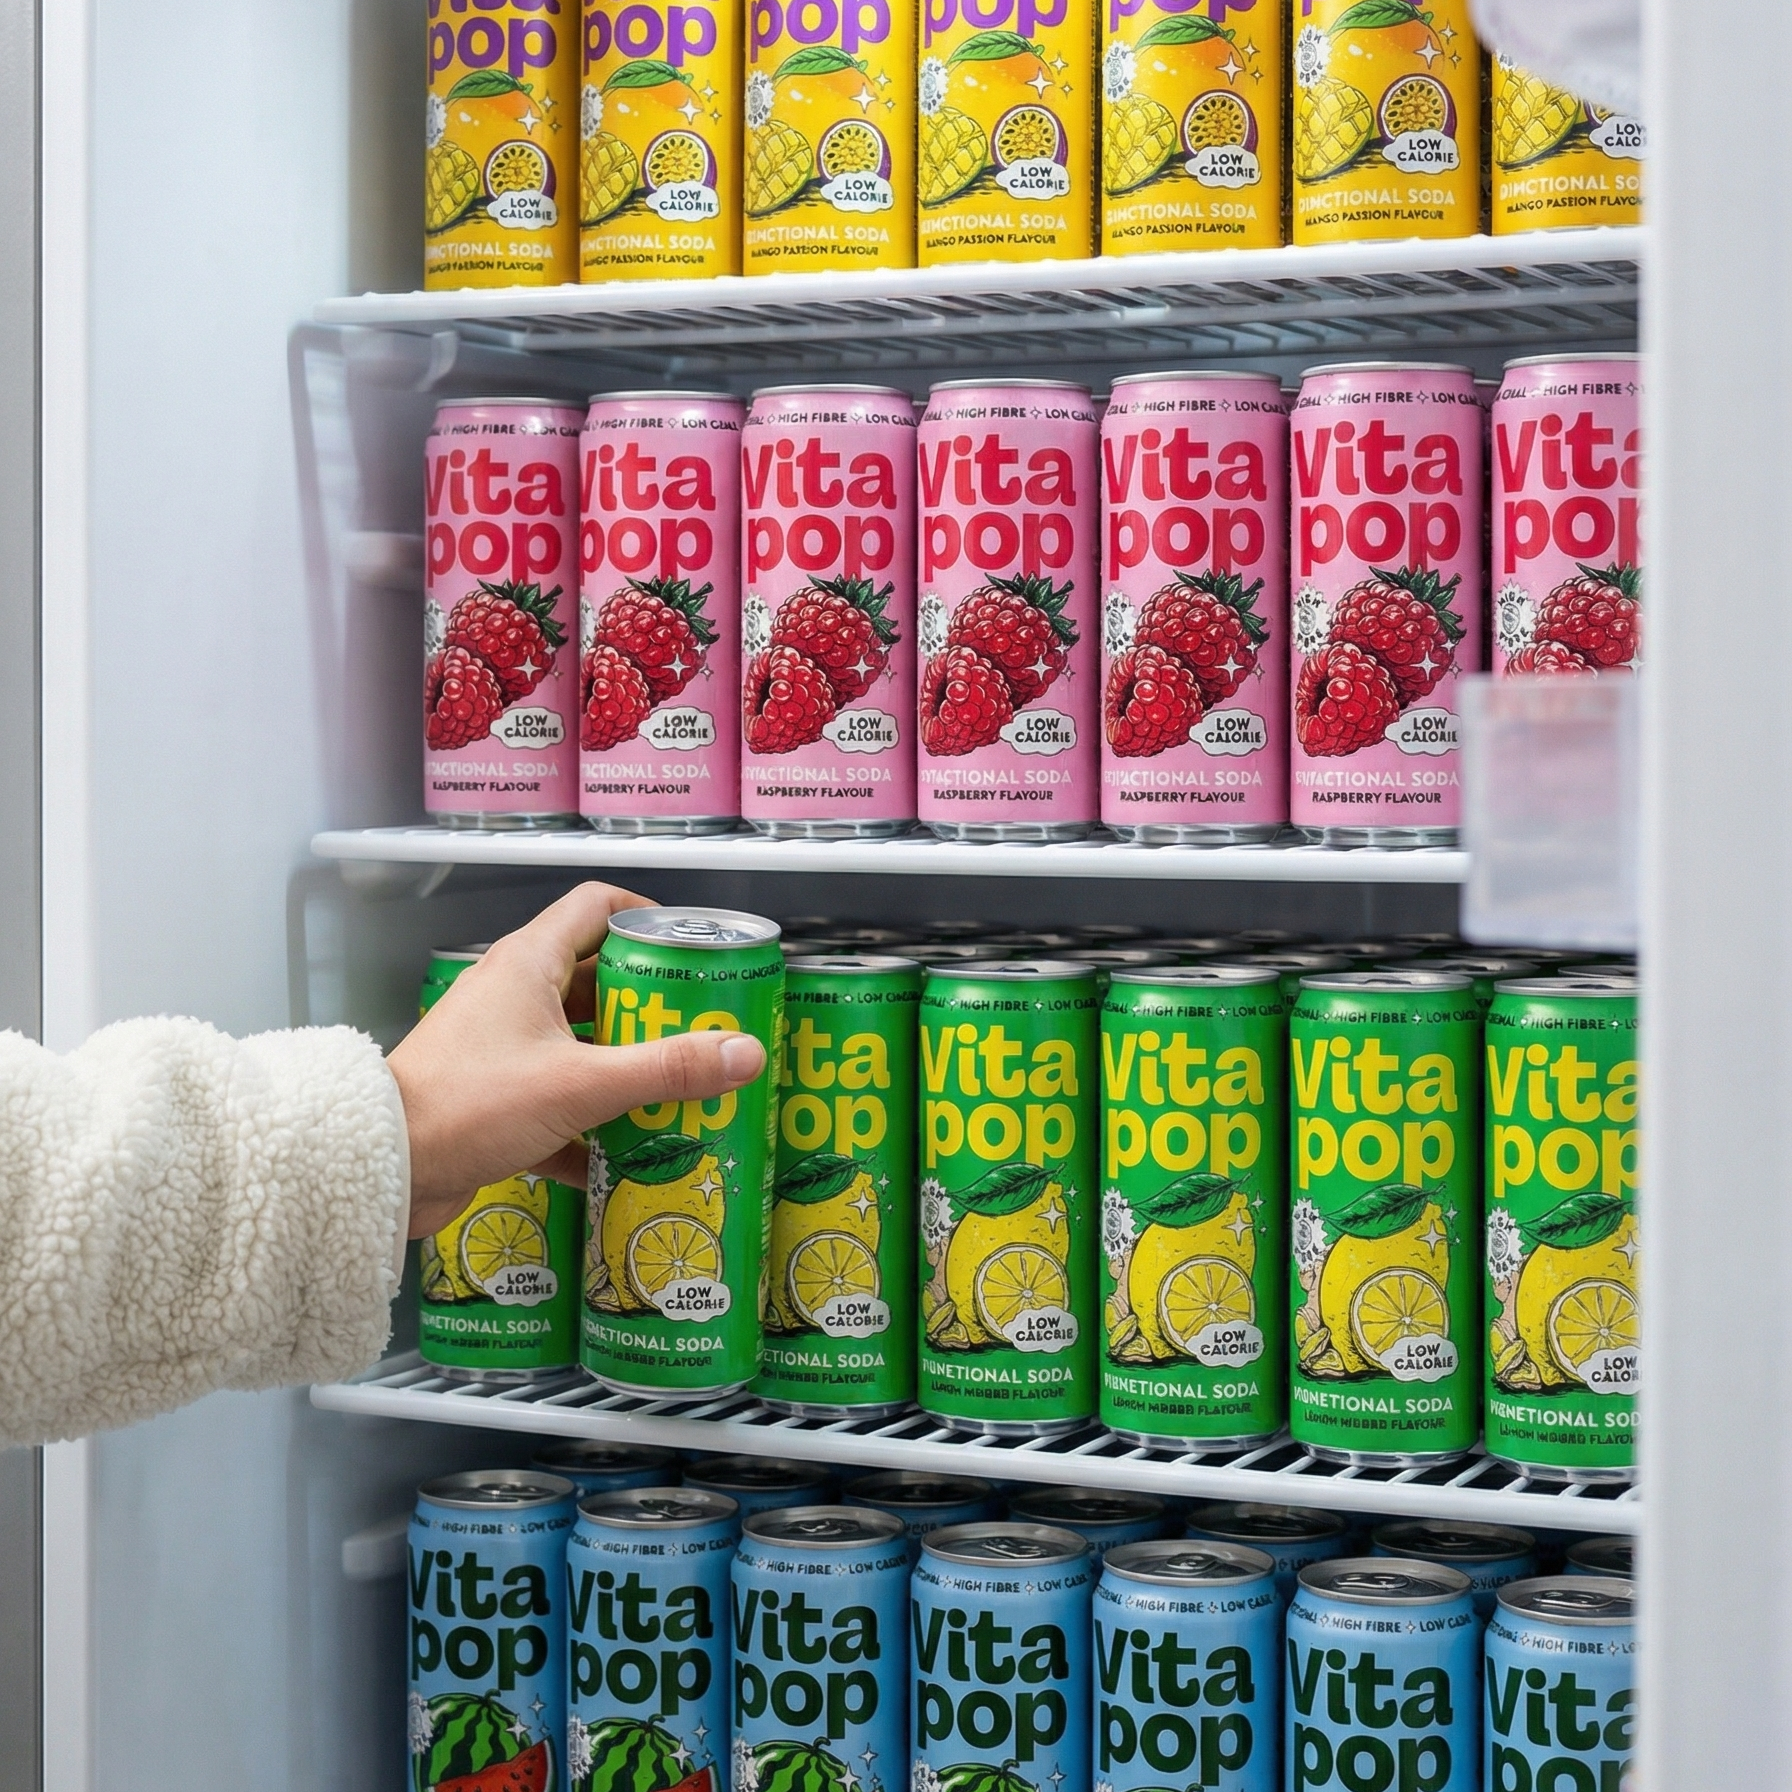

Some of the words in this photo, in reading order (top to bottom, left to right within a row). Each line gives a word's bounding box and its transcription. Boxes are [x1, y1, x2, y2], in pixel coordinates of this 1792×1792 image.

[750, 0, 891, 63] pop
[584, 4, 717, 76] pop
[429, 16, 557, 85] pop
[1409, 139, 1442, 151] LOW
[1211, 154, 1244, 165] LOW
[1021, 166, 1054, 178] LOW
[845, 179, 877, 190] LOW
[1009, 178, 1065, 190] CALORIE
[670, 189, 701, 200] LOW
[1408, 189, 1455, 206] SODA
[510, 198, 541, 208] LOW
[1209, 203, 1257, 220] SODA
[1020, 215, 1067, 230] SODA
[669, 234, 716, 250] SODA
[844, 227, 890, 242] SODA
[508, 243, 554, 258] SODA
[1338, 393, 1371, 404] HIGH
[1375, 392, 1413, 403] FIBRE
[1543, 384, 1578, 396] HIGH
[1582, 384, 1622, 395] FIBRE
[956, 408, 986, 418] HIGH
[991, 407, 1026, 418] FIBRE
[1144, 401, 1175, 411] HIGH
[1179, 400, 1216, 411] FIBRE
[630, 418, 663, 428] FIBRE
[778, 413, 807, 423] HIGH
[812, 413, 847, 422] FIBRE
[482, 424, 515, 434] FIBRE
[1104, 427, 1267, 504] Vita
[1294, 420, 1463, 498] Vita
[580, 442, 716, 513] Vita
[743, 438, 897, 510] Vita
[919, 434, 1076, 508] Vita
[425, 448, 565, 516] Vita
[924, 511, 1074, 583] pop
[1110, 506, 1265, 581] pop
[1300, 501, 1461, 577] pop
[427, 521, 562, 588] pop
[580, 517, 713, 587] pop
[747, 514, 894, 584] pop
[515, 715, 548, 726] LOW
[664, 716, 698, 727] LOW
[849, 717, 882, 730] LOW
[1026, 718, 1060, 731] LOW
[1216, 718, 1250, 730] LOW
[1413, 717, 1447, 730] LOW
[512, 762, 558, 777] SODA
[662, 764, 711, 779] SODA
[846, 767, 892, 782] SODA
[1024, 770, 1072, 784] SODA
[1215, 770, 1262, 786] SODA
[1411, 771, 1460, 787] SODA
[638, 784, 690, 794] FLAVOUR
[1190, 792, 1246, 803] FLAVOUR
[1313, 792, 1382, 803] RASPBERRY
[1385, 792, 1441, 803] FLAVOUR
[655, 967, 693, 980] FIBRE
[711, 969, 737, 982] LOW
[1177, 1006, 1213, 1018] FIBRE
[1567, 1019, 1606, 1029] FIBRE
[781, 1018, 891, 1090] ita
[921, 1023, 1079, 1098] Vita
[1102, 1030, 1265, 1107] Vita
[1292, 1036, 1458, 1114] Vita
[1487, 1043, 1641, 1123] Vita
[781, 1093, 887, 1159] op
[926, 1099, 1076, 1169] pop
[1107, 1108, 1261, 1180] pop
[1298, 1117, 1455, 1190] pop
[1494, 1125, 1643, 1198] pop
[507, 1272, 540, 1285] LOW
[676, 1286, 711, 1299] LOW
[837, 1303, 871, 1315] LOW
[507, 1318, 552, 1334] SODA
[1027, 1316, 1061, 1330] LOW
[675, 1336, 724, 1352] SODA
[1213, 1330, 1246, 1343] LOW
[1201, 1342, 1259, 1355] CALORIE
[1407, 1344, 1441, 1357] LOW
[837, 1352, 885, 1368] SODA
[1604, 1356, 1637, 1370] LOW
[1027, 1367, 1074, 1383] SODA
[1213, 1381, 1260, 1399] SODA
[1406, 1397, 1453, 1414] SODA
[1604, 1412, 1641, 1428] SOD
[682, 1541, 706, 1554] LOW
[767, 1560, 794, 1573] HIGH
[798, 1564, 832, 1575] FIBRE
[849, 1563, 873, 1574] LOW
[409, 1543, 550, 1620] Vita
[953, 1578, 982, 1592] HIGH
[986, 1582, 1020, 1592] FIBRE
[1038, 1580, 1061, 1592] LOW
[567, 1562, 714, 1644] Vita
[1169, 1602, 1204, 1613] FIBRE
[1221, 1600, 1246, 1613] LOW
[731, 1580, 881, 1665] Vita
[1332, 1617, 1362, 1630] HIGH
[1366, 1621, 1401, 1633] FIBRE
[1419, 1620, 1445, 1632] LOW
[912, 1599, 1069, 1685] Vita
[1568, 1642, 1604, 1654] FIBRE
[411, 1615, 548, 1691] pop
[1095, 1618, 1254, 1708] Vita
[570, 1639, 712, 1716] pop
[1288, 1637, 1453, 1729] Vita
[735, 1658, 879, 1740] pop
[1486, 1655, 1639, 1751] Vita
[917, 1679, 1068, 1762] pop
[1100, 1700, 1253, 1787] pop
[1295, 1721, 1452, 1792] pop
